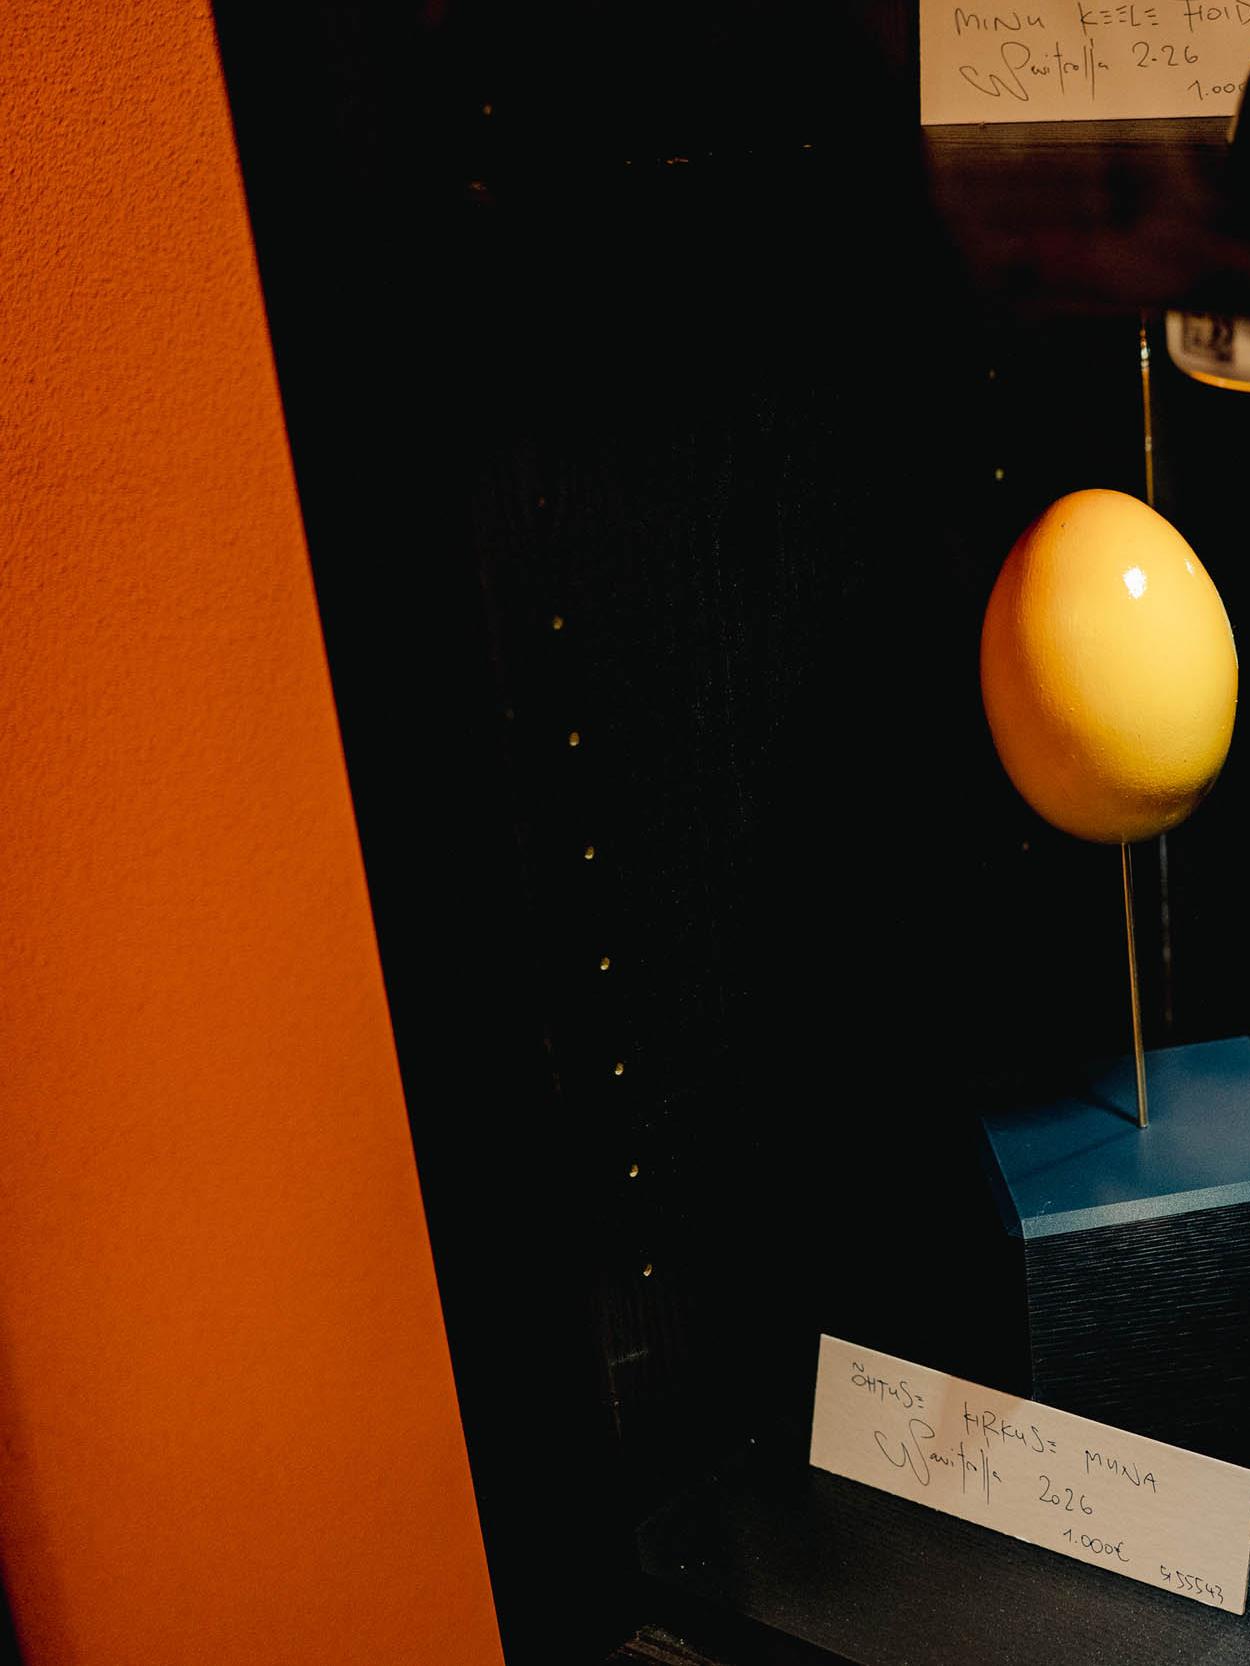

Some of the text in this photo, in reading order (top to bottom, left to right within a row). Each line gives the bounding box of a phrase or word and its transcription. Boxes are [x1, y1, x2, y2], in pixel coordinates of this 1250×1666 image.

[1078, 2, 1159, 36] KEELE
[1084, 1450, 1157, 1494] MUNA
[1039, 1475, 1093, 1515] 2026
[1063, 1529, 1130, 1562] 1.000€
